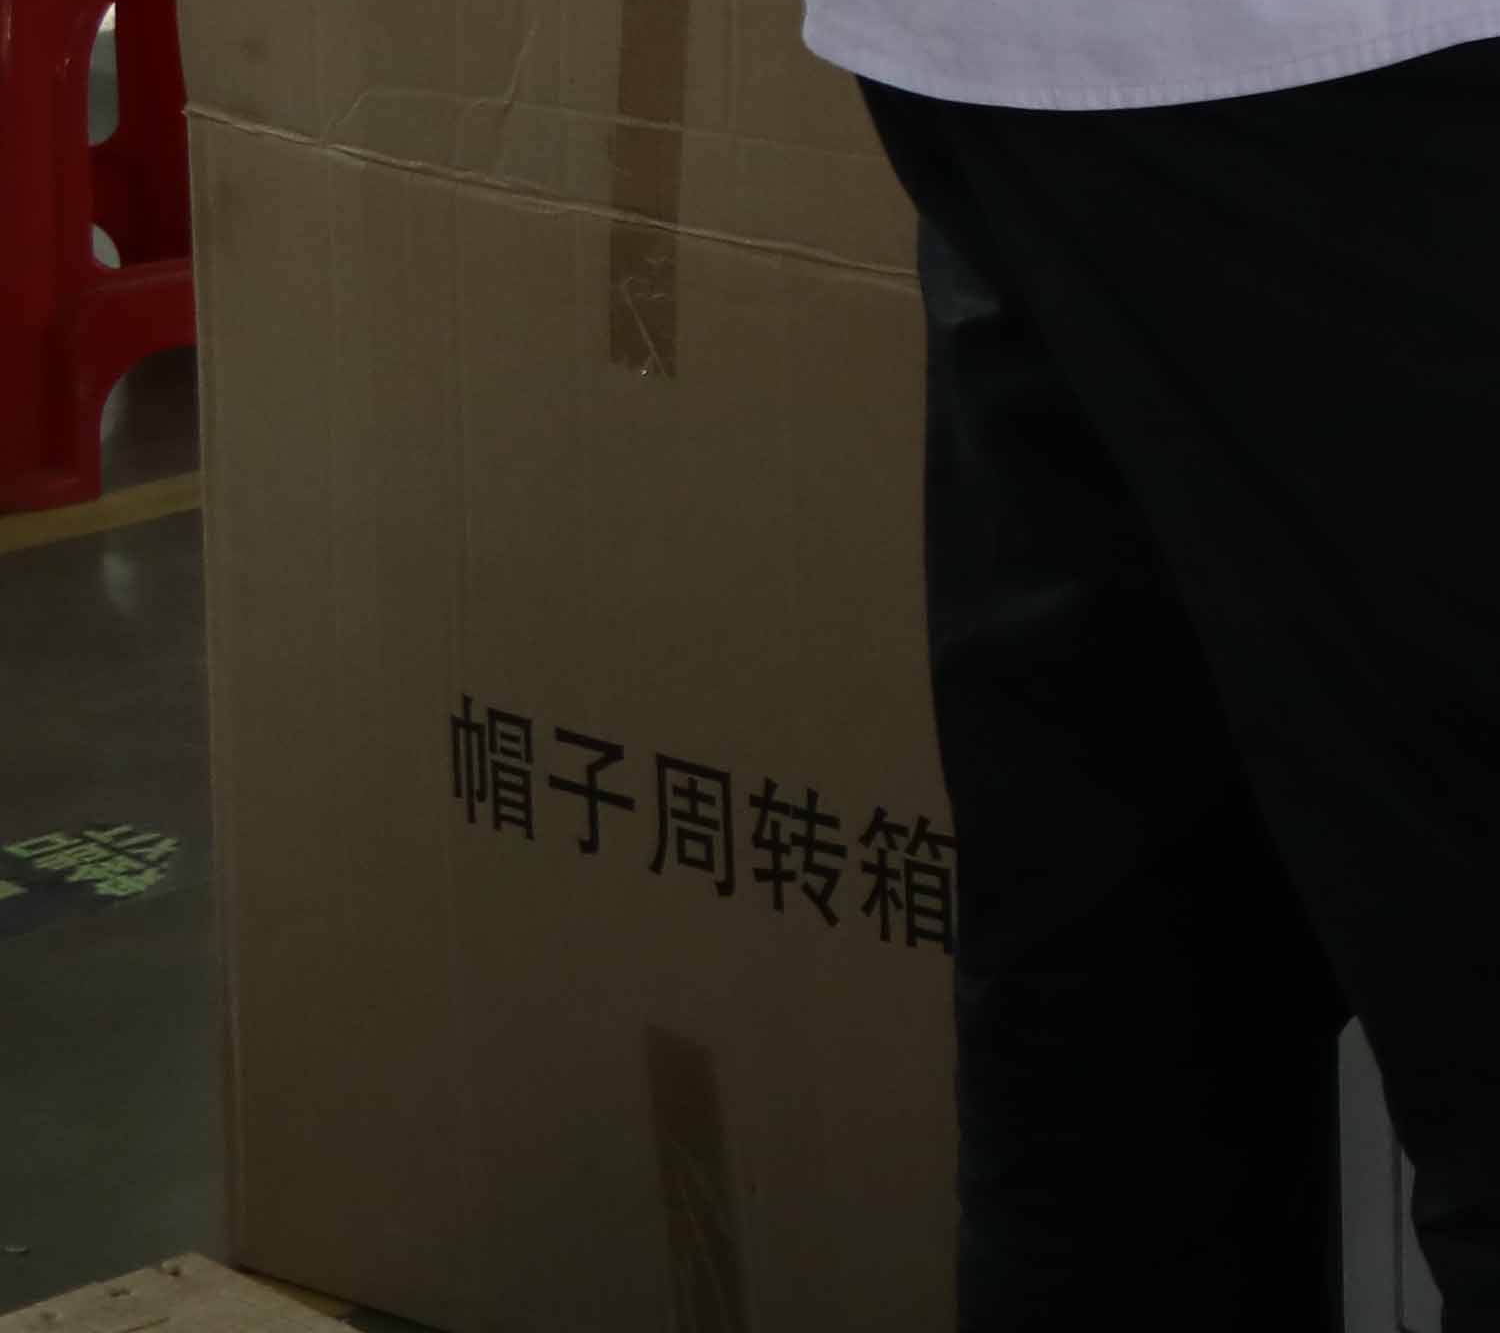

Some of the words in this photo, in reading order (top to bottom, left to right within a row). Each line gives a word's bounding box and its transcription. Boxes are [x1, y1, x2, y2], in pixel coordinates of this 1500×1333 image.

[450, 693, 957, 955] 帽子周转箱
